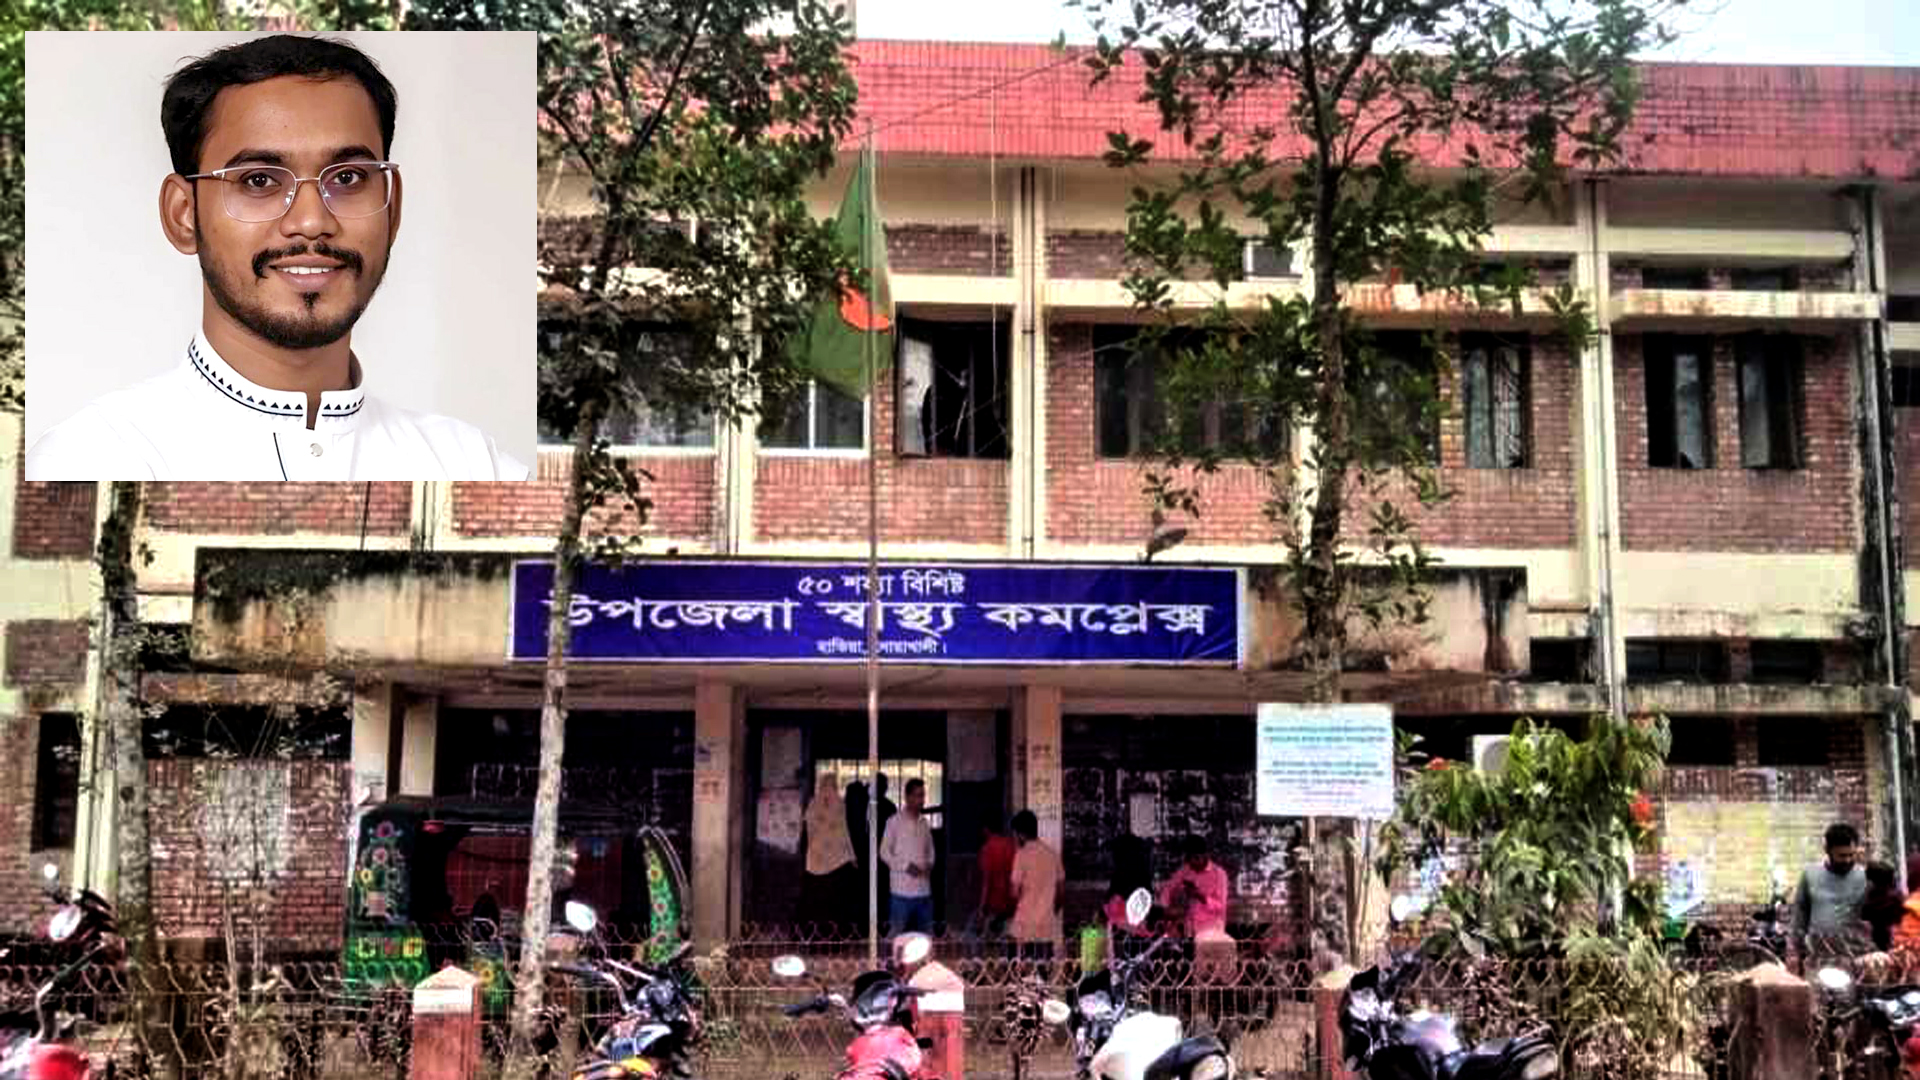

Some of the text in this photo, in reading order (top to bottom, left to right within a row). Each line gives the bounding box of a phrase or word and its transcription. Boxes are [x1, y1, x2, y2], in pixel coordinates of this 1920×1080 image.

[798, 576, 832, 595] ৫০
[900, 569, 965, 597] বিশিষ্ট
[817, 599, 966, 638] স্বাস্থ্য
[976, 600, 1213, 635] কমপ্লেক্স
